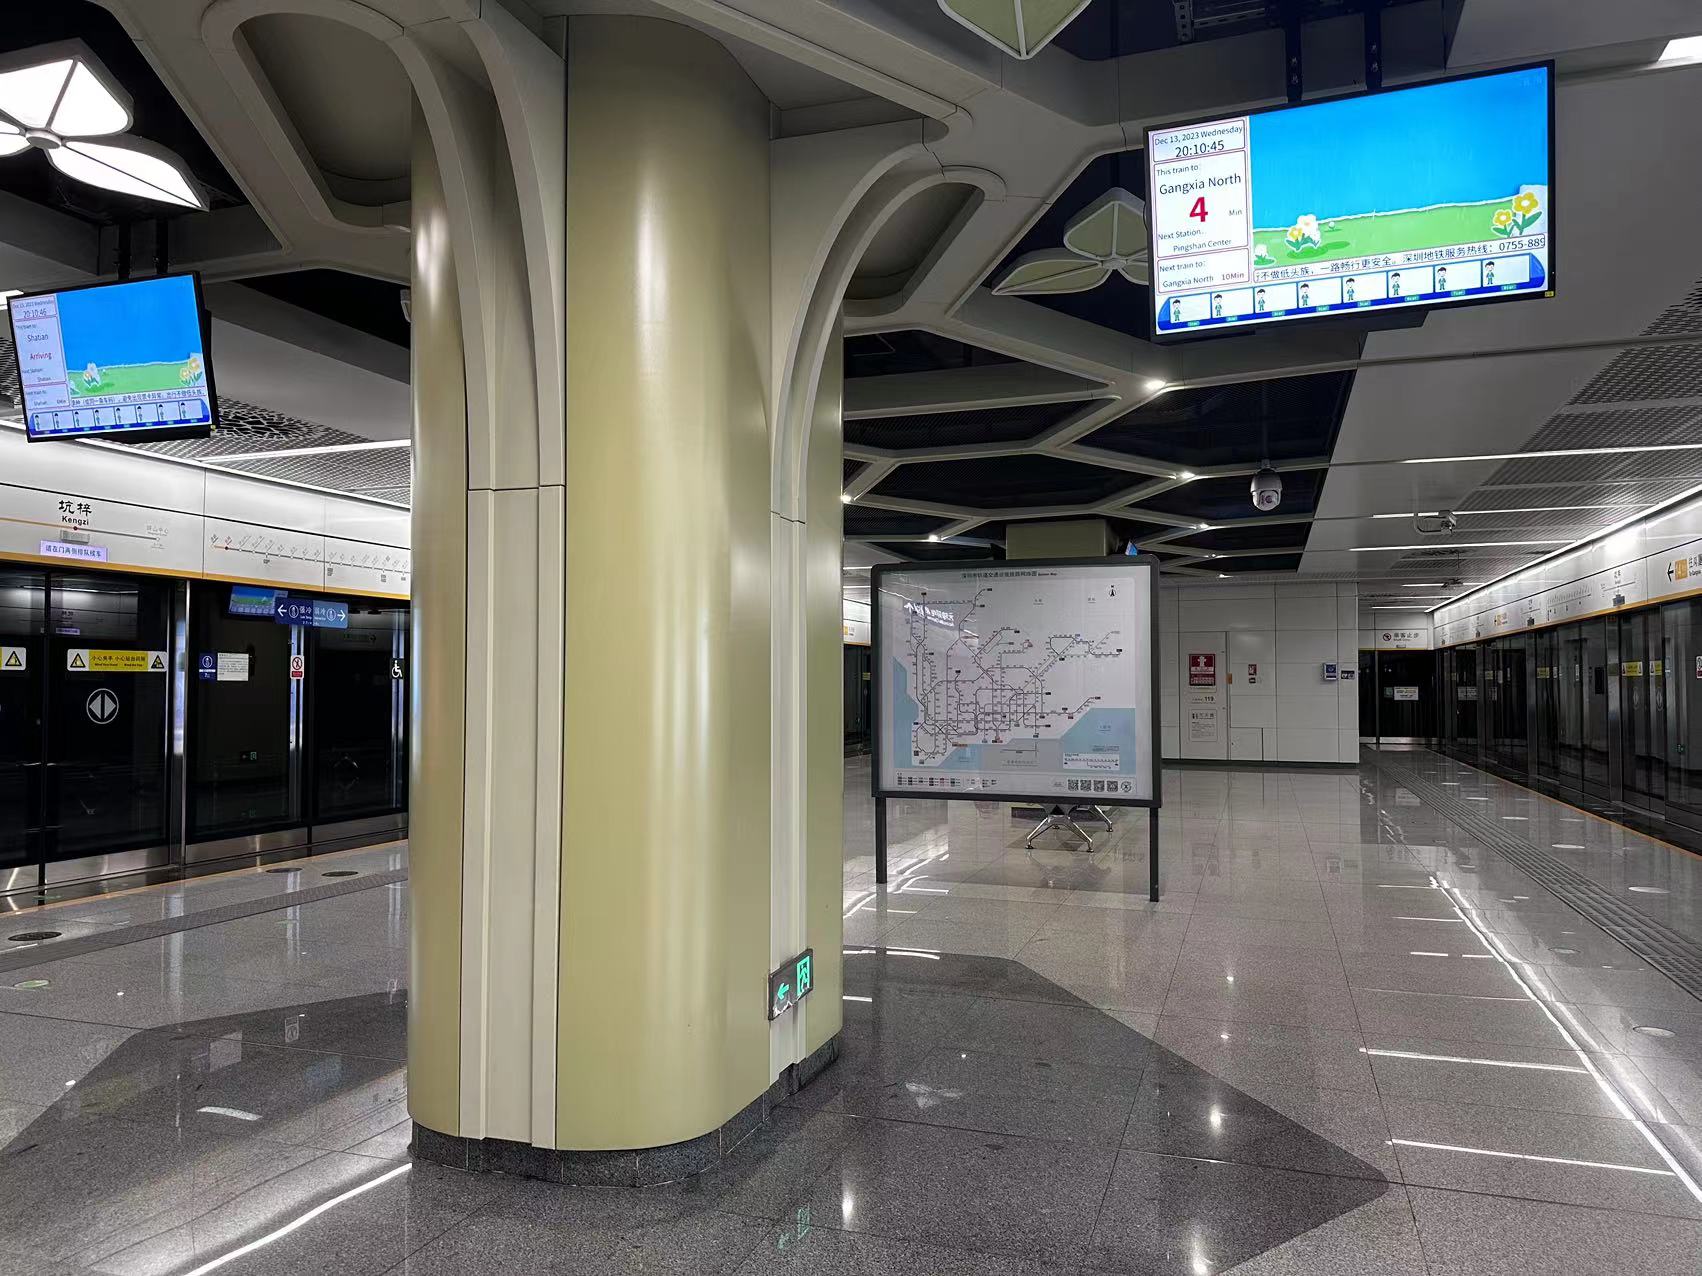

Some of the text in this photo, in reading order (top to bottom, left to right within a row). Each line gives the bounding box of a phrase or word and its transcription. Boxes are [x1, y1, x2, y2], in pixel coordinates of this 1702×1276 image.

[1154, 125, 1243, 145] Dec 13, 2023 Wednesday
[1175, 140, 1225, 158] 20:10:45
[1156, 167, 1171, 176] This
[1172, 165, 1189, 174] train
[1159, 173, 1242, 195] Gangxia North
[1189, 196, 1208, 222] 4
[1228, 208, 1243, 216] Min
[1158, 232, 1174, 241] Next
[1173, 238, 1232, 253] Pingshan Center
[1159, 263, 1175, 273] Next
[1176, 261, 1194, 270] train
[1162, 271, 1244, 288] Gangxia North 10Min
[58, 500, 93, 516] 坑梓
[62, 515, 89, 526] Kengzi
